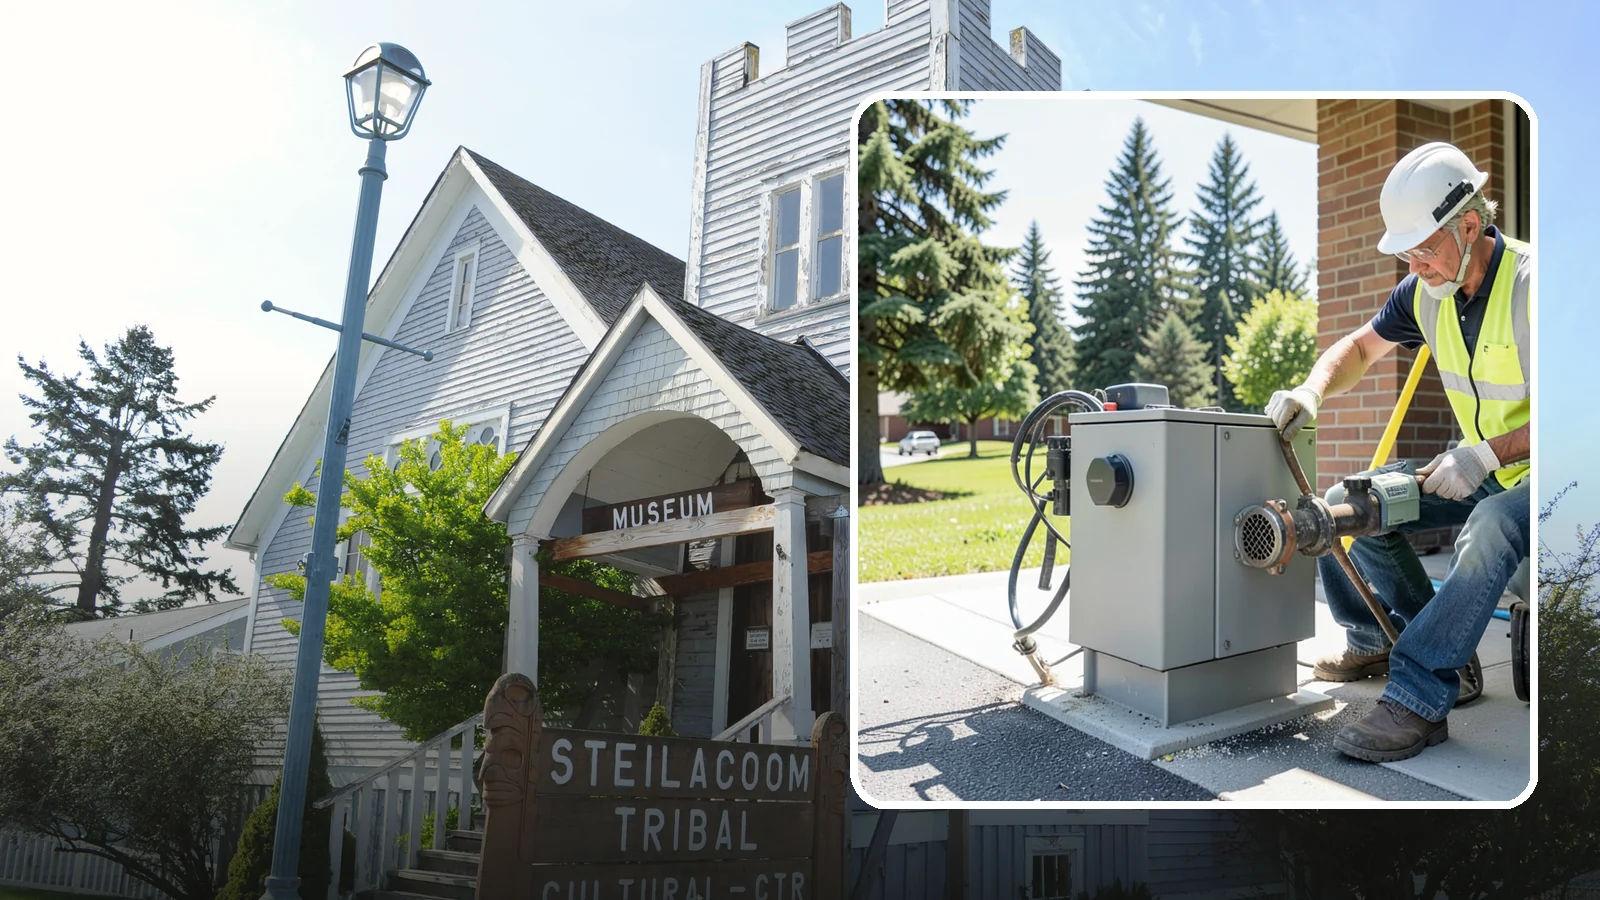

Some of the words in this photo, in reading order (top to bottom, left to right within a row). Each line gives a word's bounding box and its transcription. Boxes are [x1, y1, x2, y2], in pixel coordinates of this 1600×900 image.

[613, 492, 713, 530] MUSEUM
[551, 738, 809, 792] STEILACOOM
[615, 807, 758, 850] TRIBAL
